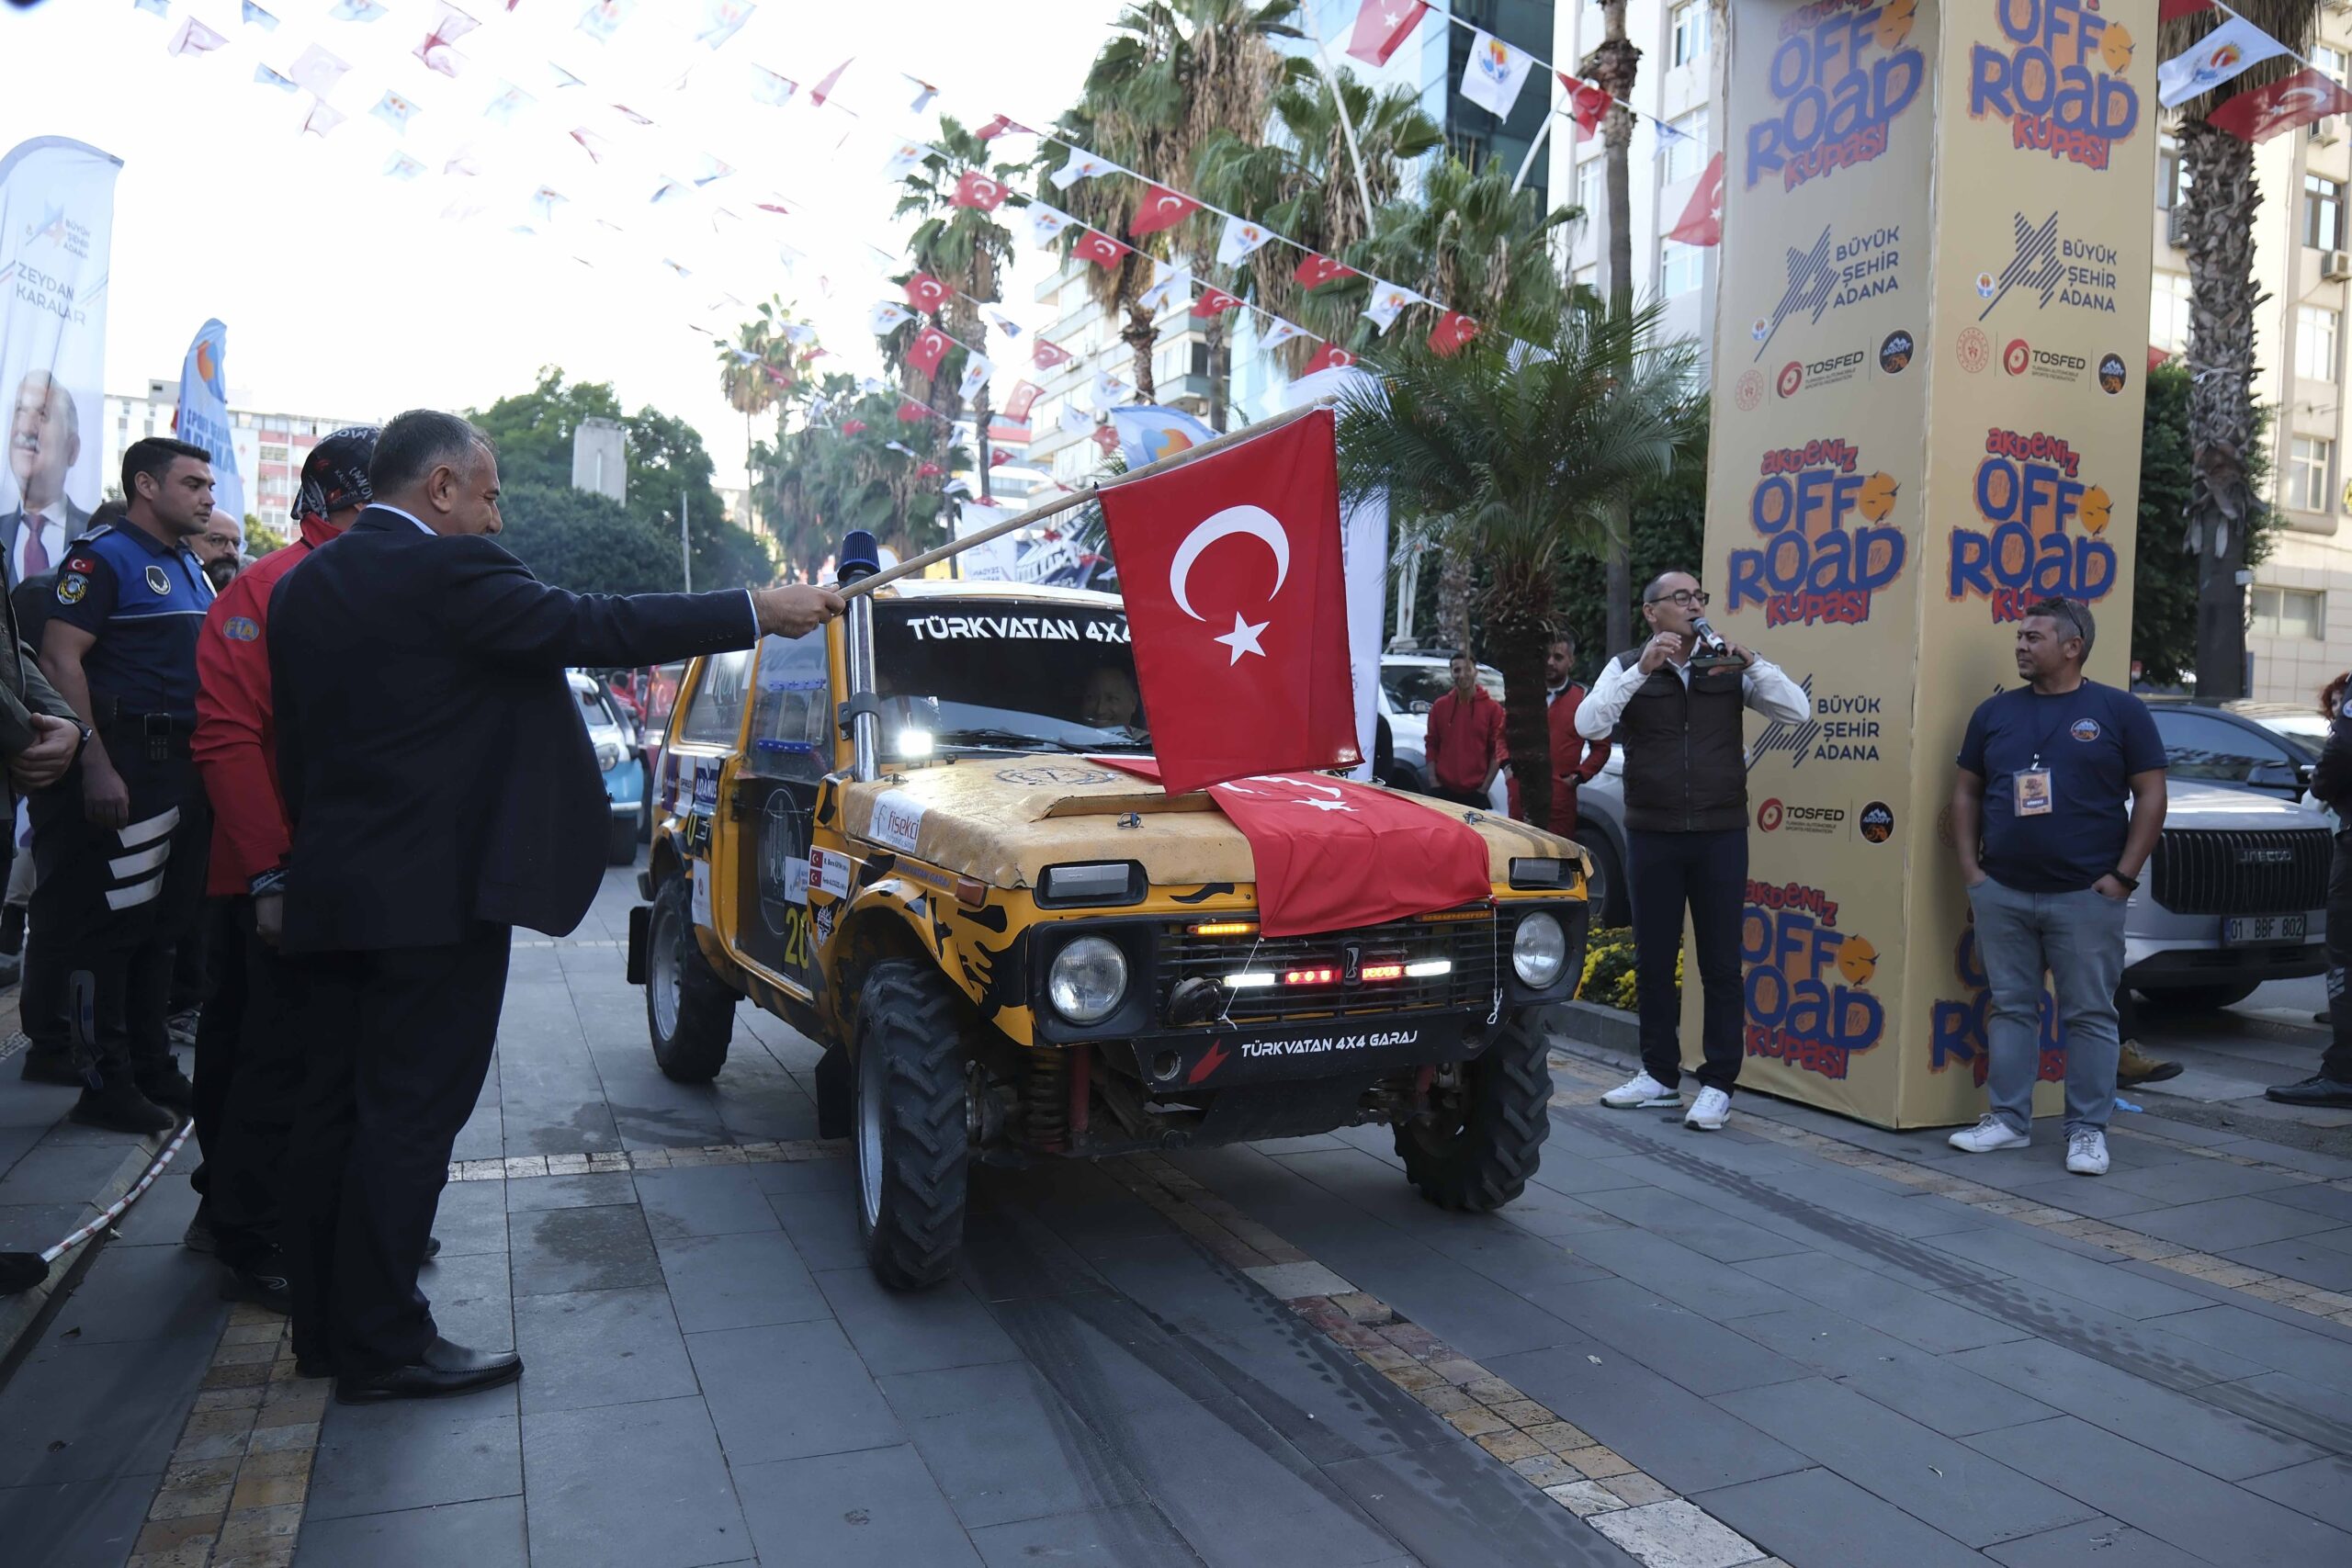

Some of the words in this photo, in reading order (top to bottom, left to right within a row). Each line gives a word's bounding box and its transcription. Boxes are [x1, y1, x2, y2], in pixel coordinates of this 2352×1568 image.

[1999, 0, 2107, 64] OFF
[1770, 6, 1883, 100] OFF
[1836, 225, 1900, 262] BÜYÜK
[2063, 239, 2117, 265] BÜYÜK
[17, 261, 74, 301] ZEYDAN
[1842, 251, 1899, 288] ŞEHİR
[2067, 265, 2116, 290] ŞEHİR
[16, 283, 86, 325] KARALAR
[1833, 276, 1899, 309] ADANA
[2059, 288, 2116, 313] ADANA
[1806, 350, 1864, 376] TOSFED
[2032, 350, 2086, 369] TOSFED
[1753, 469, 1865, 534] OFF
[1977, 457, 2085, 533] OFF
[225, 620, 254, 637] FIA
[907, 615, 1079, 640] TÜRKVATAN
[1817, 695, 1881, 714] BÜYÜK
[1824, 717, 1880, 742] ŞEHİR
[1814, 744, 1880, 761] ADANA
[1786, 807, 1845, 821] TOSFED
[2231, 919, 2243, 939] 01
[2255, 919, 2275, 938] BBF
[2282, 918, 2302, 937] 802
[1740, 906, 1845, 980] OFF
[1241, 1038, 1332, 1057] TÜRKVATAN
[1335, 1034, 1366, 1050] 4X4
[1369, 1030, 1419, 1047] GARAJ
